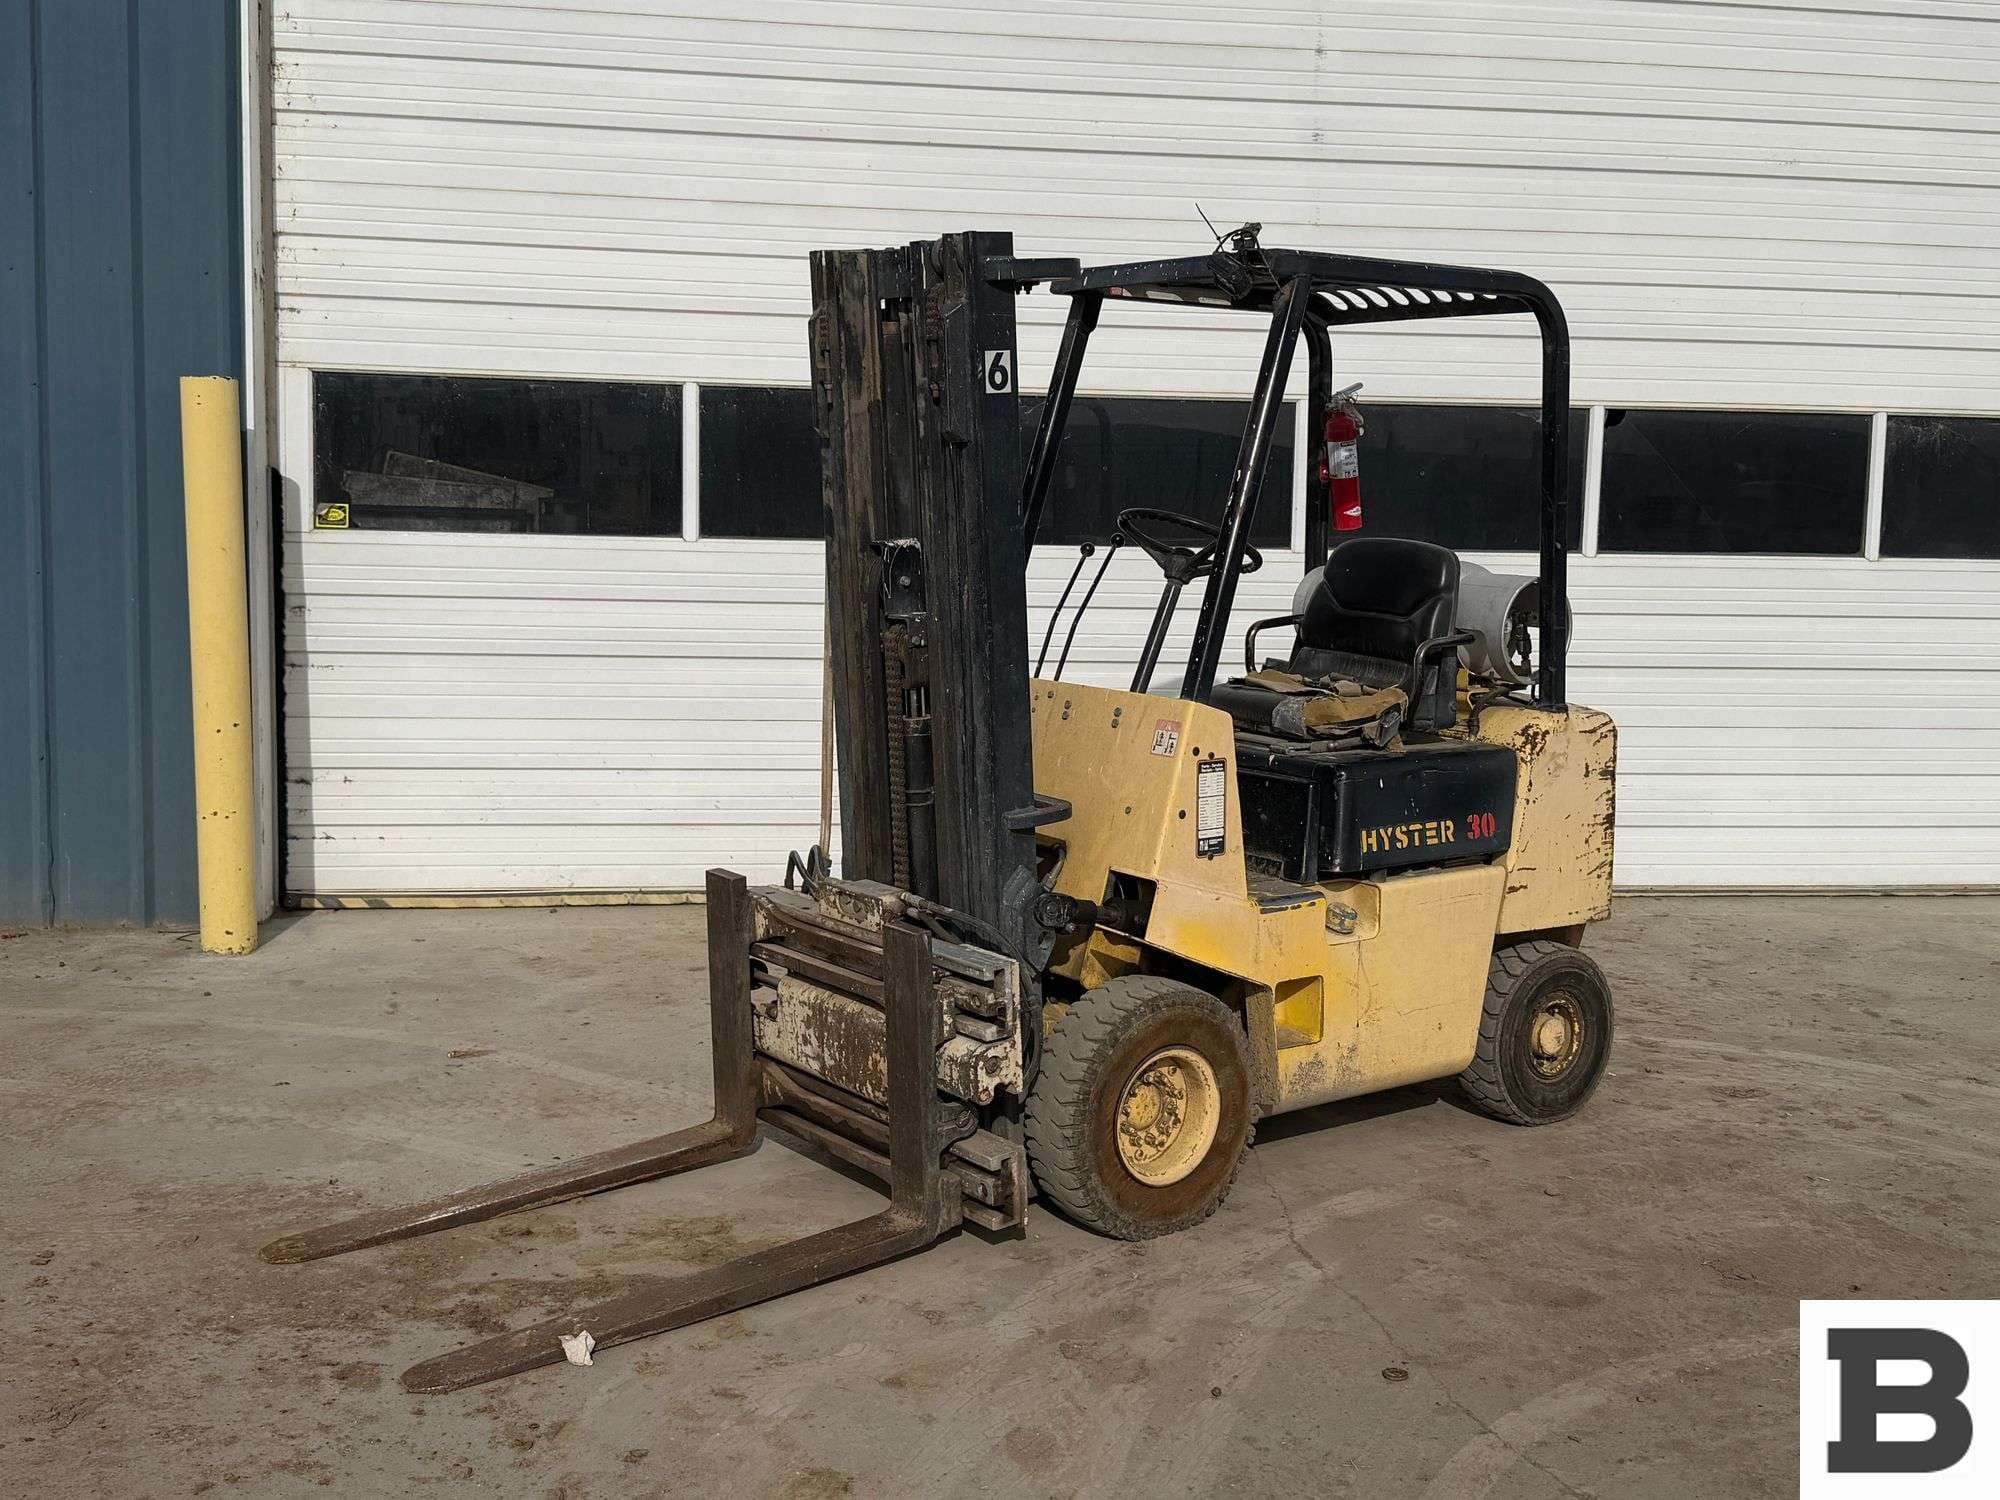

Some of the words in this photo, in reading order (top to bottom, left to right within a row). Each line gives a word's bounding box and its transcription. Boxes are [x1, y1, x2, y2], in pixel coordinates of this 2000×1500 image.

[988, 352, 1009, 391] 6
[1361, 820, 1455, 853] HYSTER
[1466, 812, 1496, 840] 30
